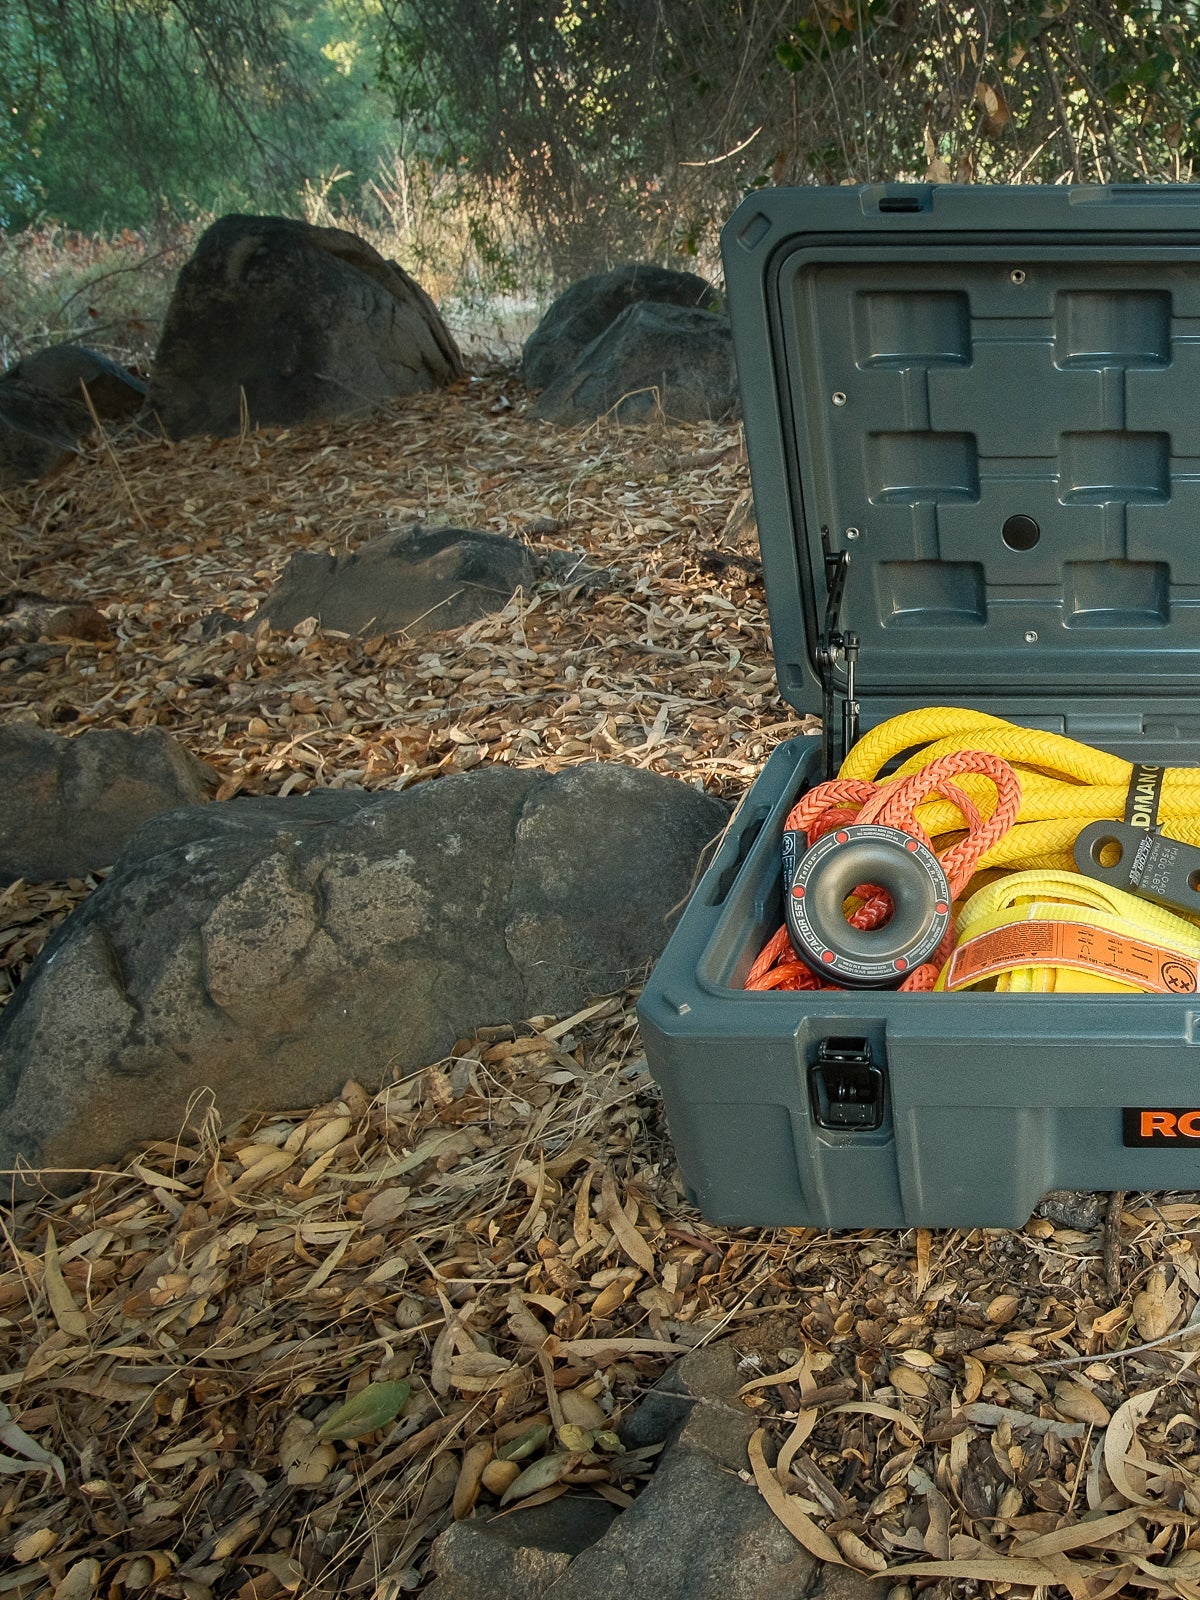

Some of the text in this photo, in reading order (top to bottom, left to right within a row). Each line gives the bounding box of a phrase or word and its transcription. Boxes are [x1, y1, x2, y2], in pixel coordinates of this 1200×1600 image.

[1131, 772, 1158, 831] DMAN
[1156, 871, 1171, 895] LOAD
[798, 919, 823, 952] FACTOR
